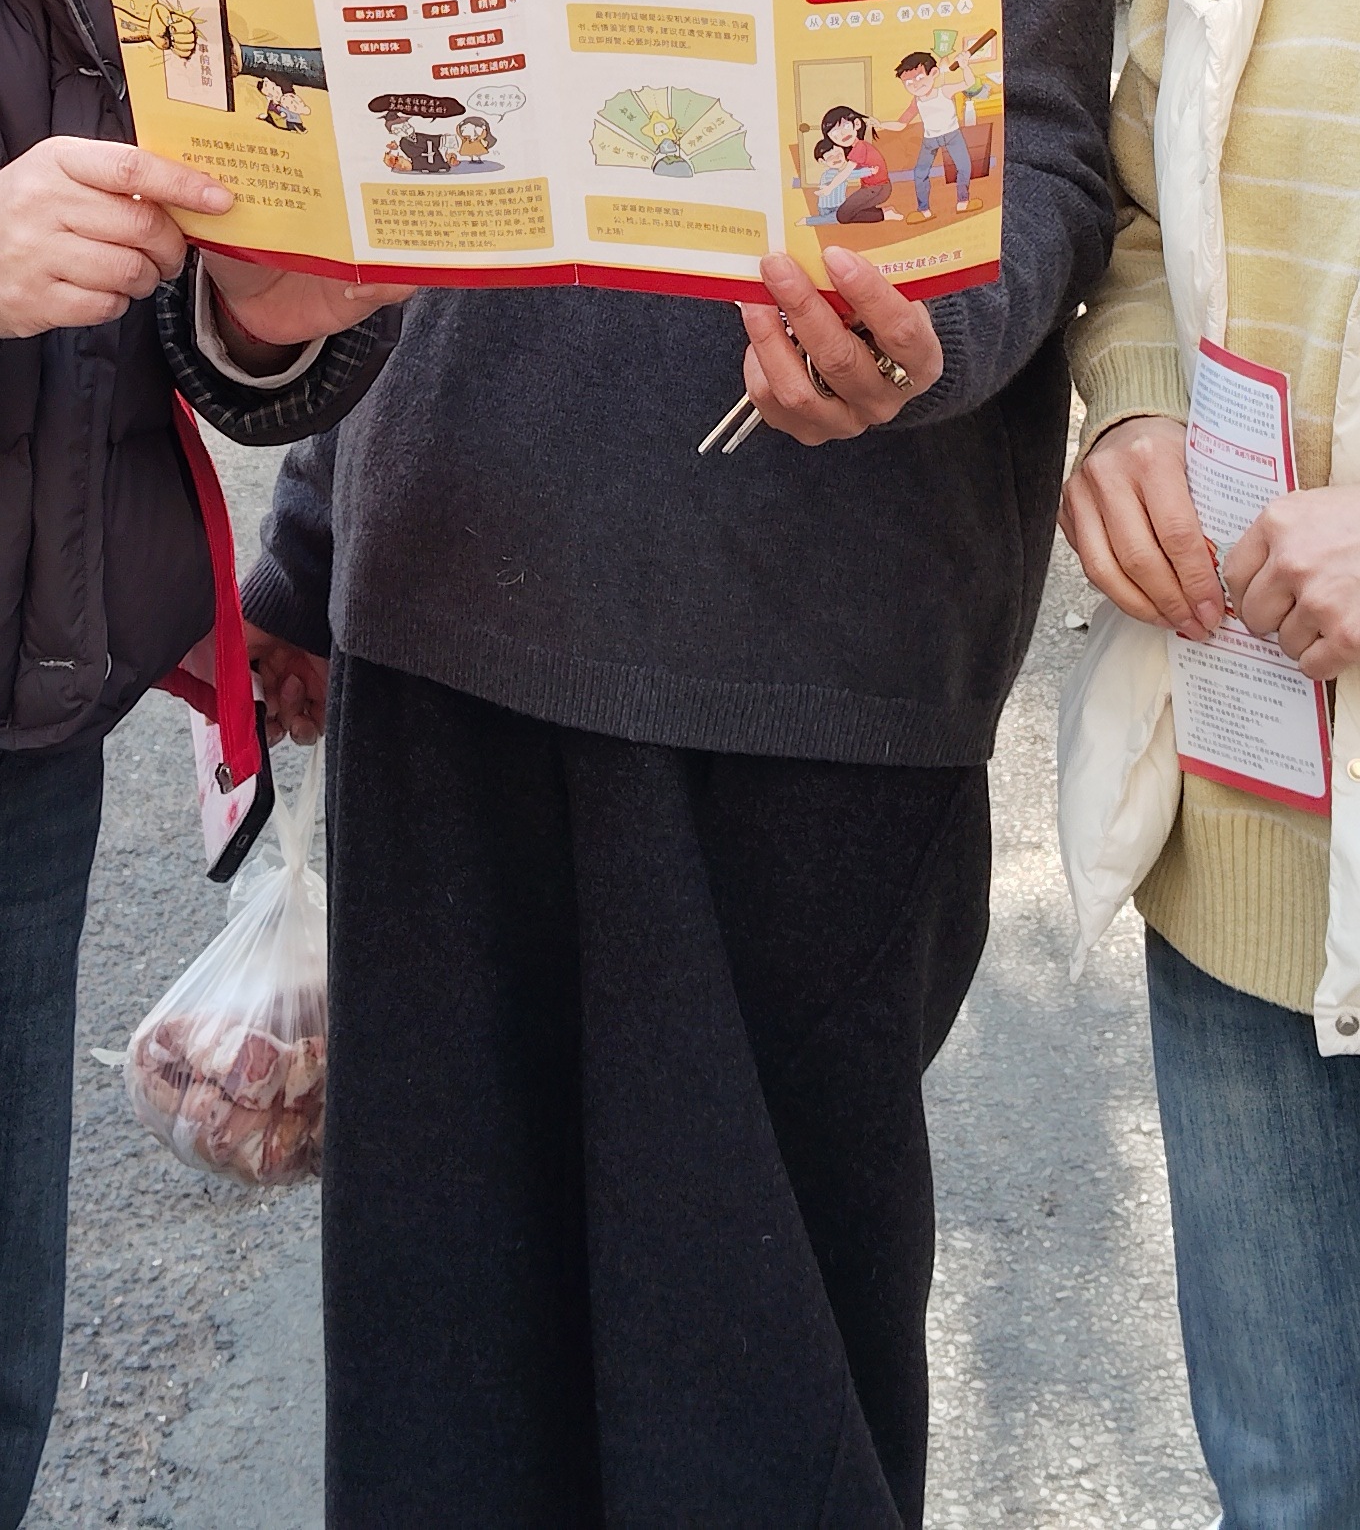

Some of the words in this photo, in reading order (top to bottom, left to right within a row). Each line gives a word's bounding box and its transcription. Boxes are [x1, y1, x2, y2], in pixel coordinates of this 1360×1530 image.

[809, 12, 881, 28] 从我做起
[900, 0, 971, 20] 善待家人
[252, 49, 310, 70] 反家暴法
[191, 136, 290, 160] 预防和制止家庭暴力
[181, 152, 305, 178] 保护家庭成员的合法权益
[875, 253, 949, 274] 市妇女联合会
